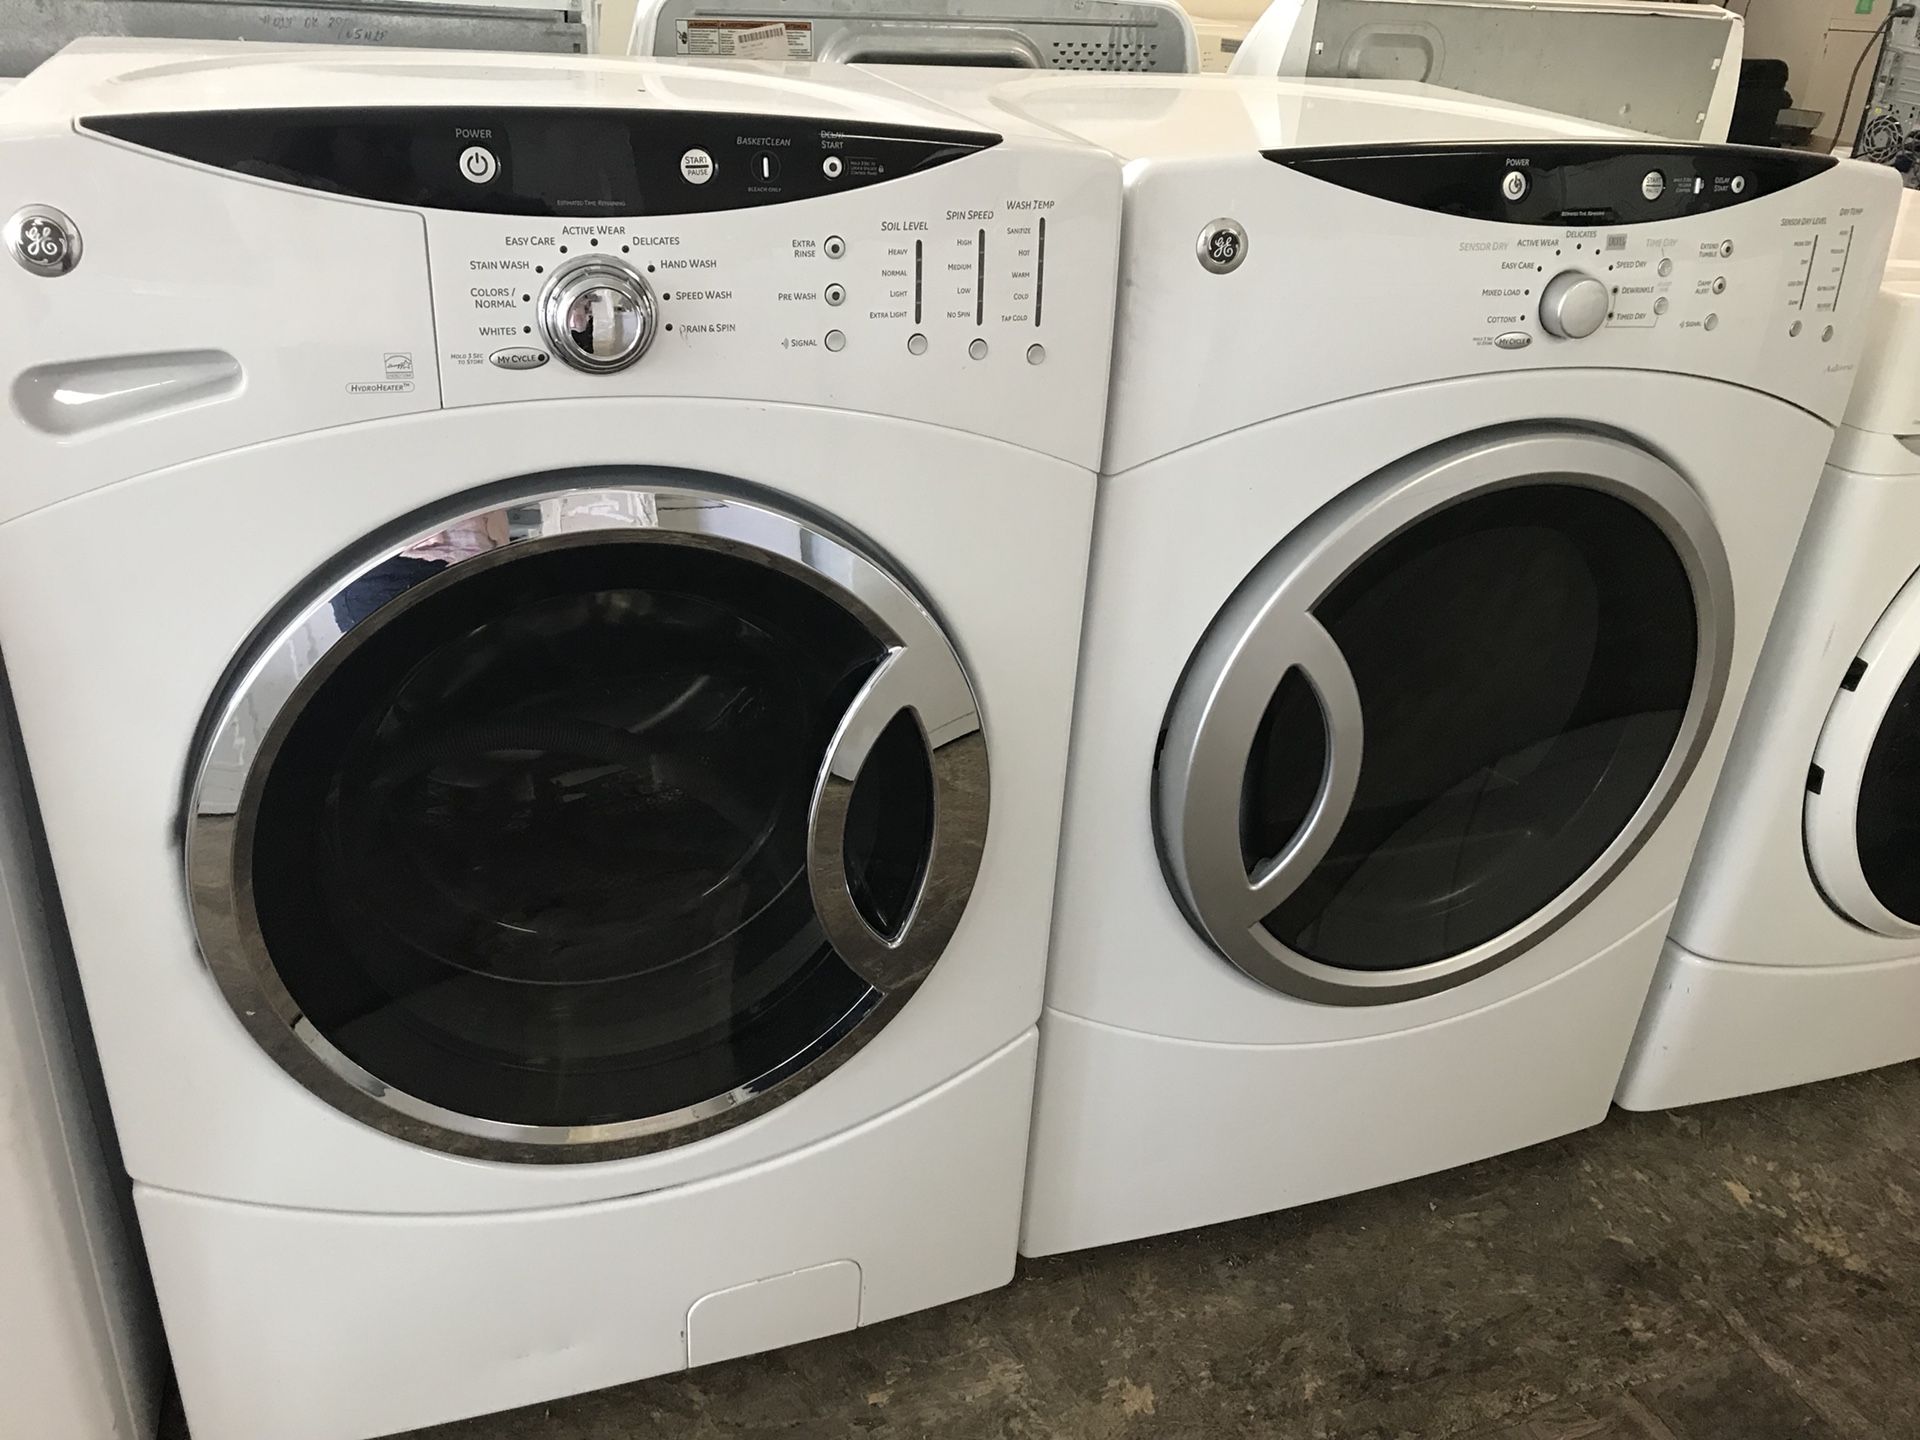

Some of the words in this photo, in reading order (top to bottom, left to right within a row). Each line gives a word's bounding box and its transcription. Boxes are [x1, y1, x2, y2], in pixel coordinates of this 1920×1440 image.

[455, 128, 492, 139] POWER
[736, 136, 792, 147] BASKETCLEAN
[821, 141, 844, 149] START
[684, 155, 709, 165] START
[1505, 158, 1530, 167] POWER
[687, 168, 709, 177] PAUSE
[1646, 176, 1663, 184] START
[1006, 200, 1032, 210] WASH
[1033, 200, 1055, 210] TEMP
[946, 211, 967, 221] SPIN
[968, 210, 994, 220] SPEED
[562, 225, 595, 235] ACTIVE
[596, 225, 626, 235] WEAR
[881, 221, 902, 232] SOIL
[903, 221, 929, 231] LEVEL
[1565, 230, 1597, 238] DELICATES
[505, 236, 529, 246] EASY
[530, 236, 556, 246] CARE
[632, 236, 680, 246] DELICATES
[792, 239, 816, 248] EXTRA
[1517, 239, 1540, 247] ACTIVE
[1540, 239, 1560, 247] WEAR
[1459, 242, 1491, 252] SENSOR
[1491, 242, 1509, 251] DRY
[794, 249, 816, 258] RINSE
[888, 248, 908, 256] HEAVY
[1018, 249, 1031, 257] HOT
[469, 260, 498, 270] STAIN
[499, 260, 530, 270] WASH
[660, 259, 688, 269] HAND
[688, 259, 717, 269] WASH
[947, 263, 972, 271] MEDIUM
[1501, 262, 1518, 270] EASY
[1616, 261, 1635, 269] SPEED
[1635, 260, 1648, 268] DRY
[881, 269, 908, 277] NORMAL
[1011, 271, 1030, 279] WARM
[470, 288, 508, 298] COLORS
[675, 290, 703, 300] SPEED
[704, 290, 732, 300] WASH
[889, 290, 908, 298] LIGHT
[956, 287, 971, 295] LOW
[1481, 289, 1503, 297] MIXED
[778, 292, 793, 301] PRE
[793, 292, 817, 301] WASH
[474, 299, 517, 309] NORMAL
[869, 311, 889, 319] EXTRA
[890, 310, 908, 319] LIGHT
[946, 311, 956, 319] NO
[956, 310, 971, 318] SPIN
[1012, 314, 1028, 322] COLD
[1616, 313, 1634, 321] TIMED
[1487, 316, 1517, 324] COTTONS
[479, 326, 517, 336] WHITES
[708, 324, 715, 333] &
[715, 323, 736, 333] SPIN
[791, 339, 818, 348] SIGNAL
[497, 355, 511, 365] MY
[512, 354, 537, 364] CYCLE
